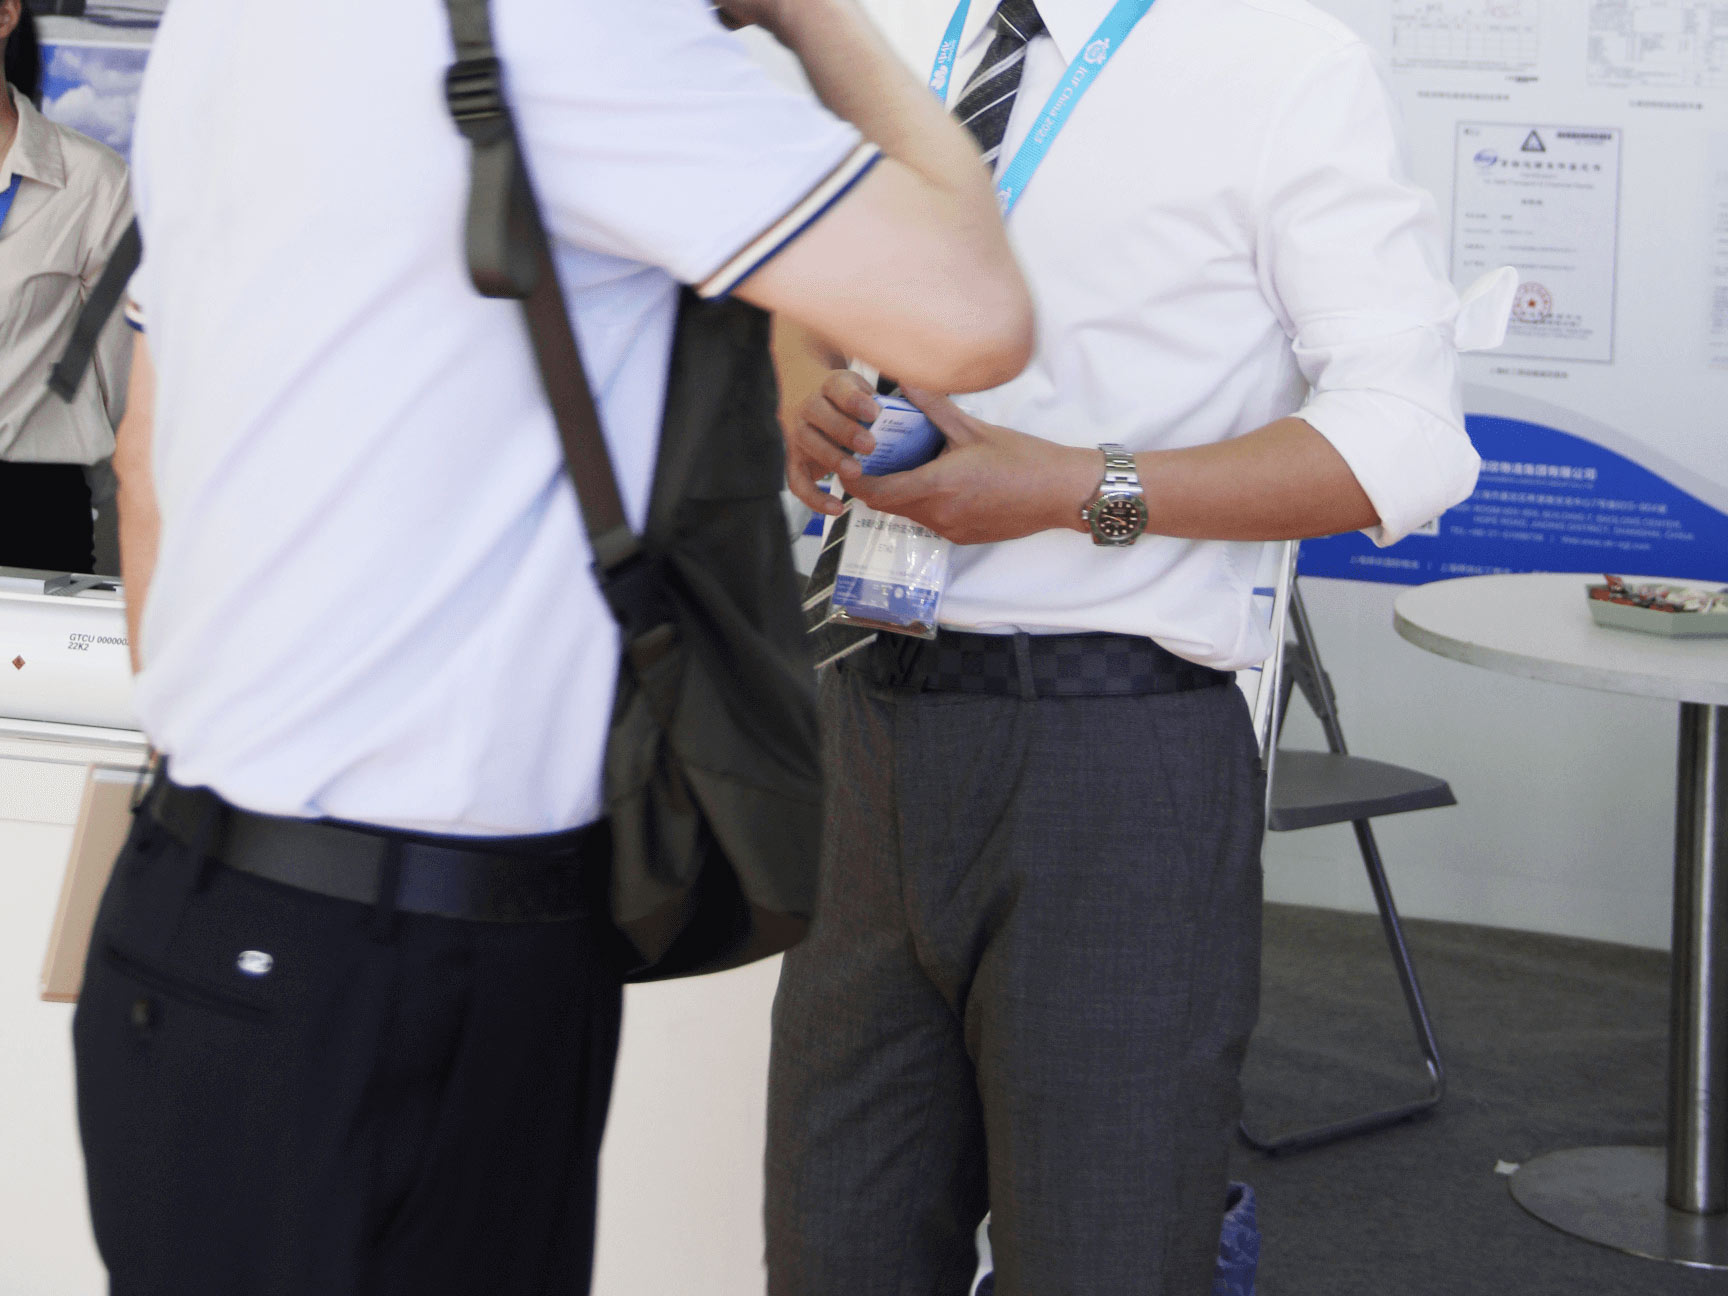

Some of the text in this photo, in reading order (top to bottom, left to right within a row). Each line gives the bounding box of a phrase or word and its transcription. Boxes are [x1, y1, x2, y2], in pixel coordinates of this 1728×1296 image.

[1050, 87, 1073, 117] China
[67, 641, 90, 651] 22K2
[69, 633, 129, 646] GTCU 000000
